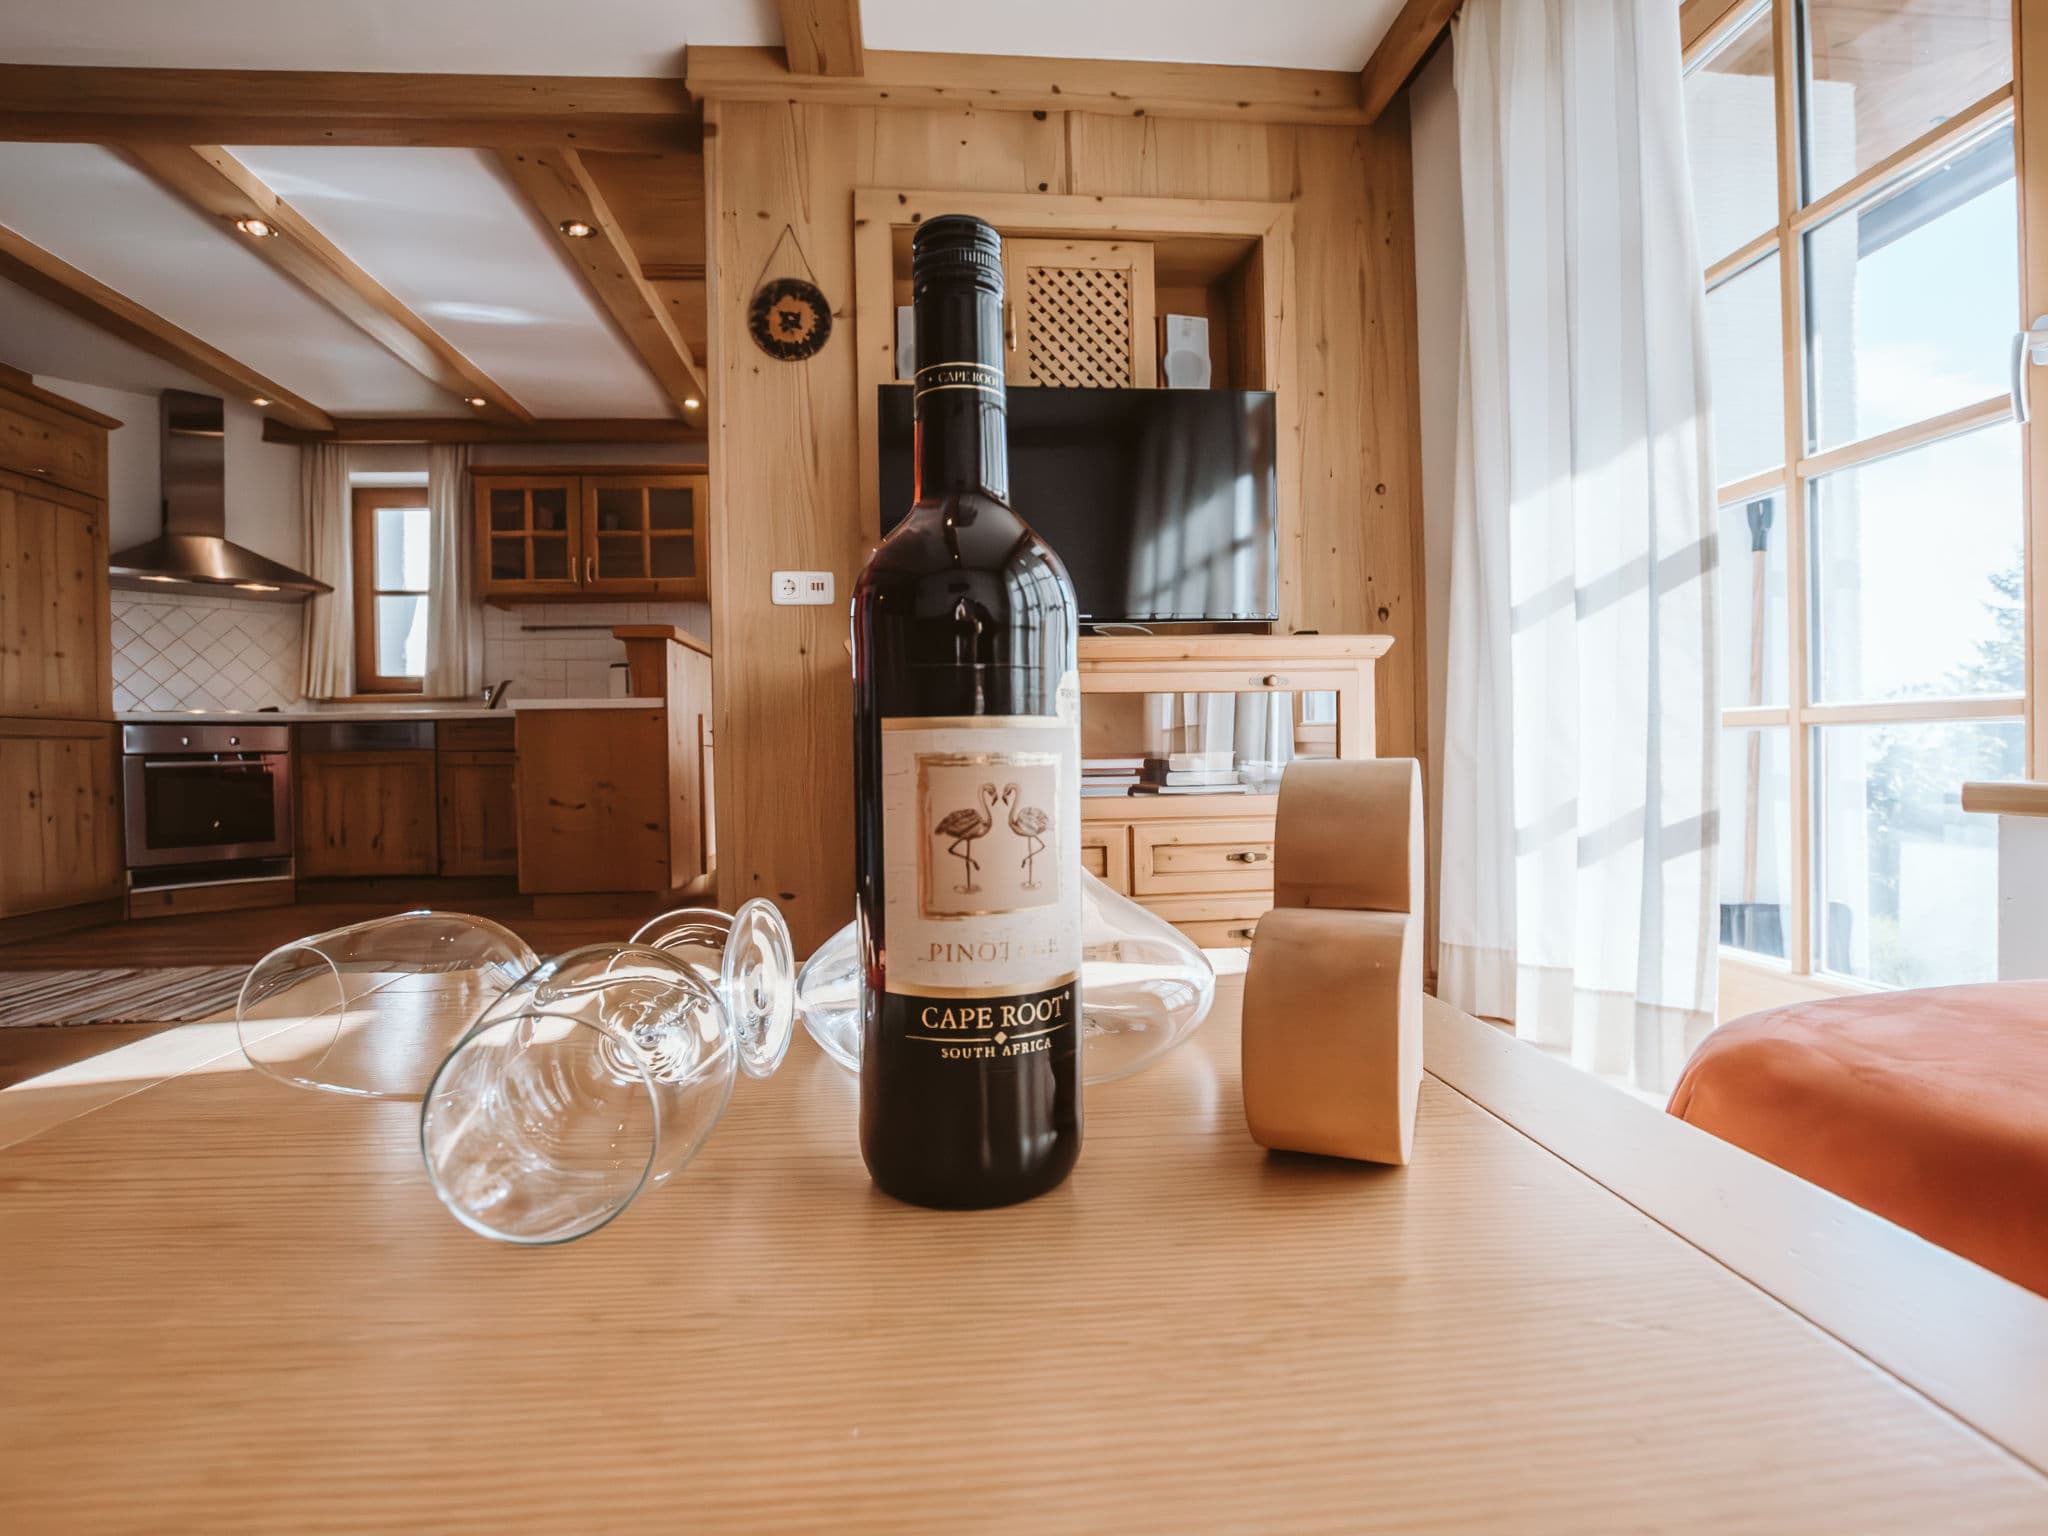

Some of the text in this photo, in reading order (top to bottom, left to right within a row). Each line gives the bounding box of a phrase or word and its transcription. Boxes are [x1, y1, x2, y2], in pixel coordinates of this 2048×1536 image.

[938, 370, 970, 382] CAPE
[921, 995, 1063, 1030] CAPE ROOT
[941, 1037, 1053, 1060] SOUTH AFRICA
